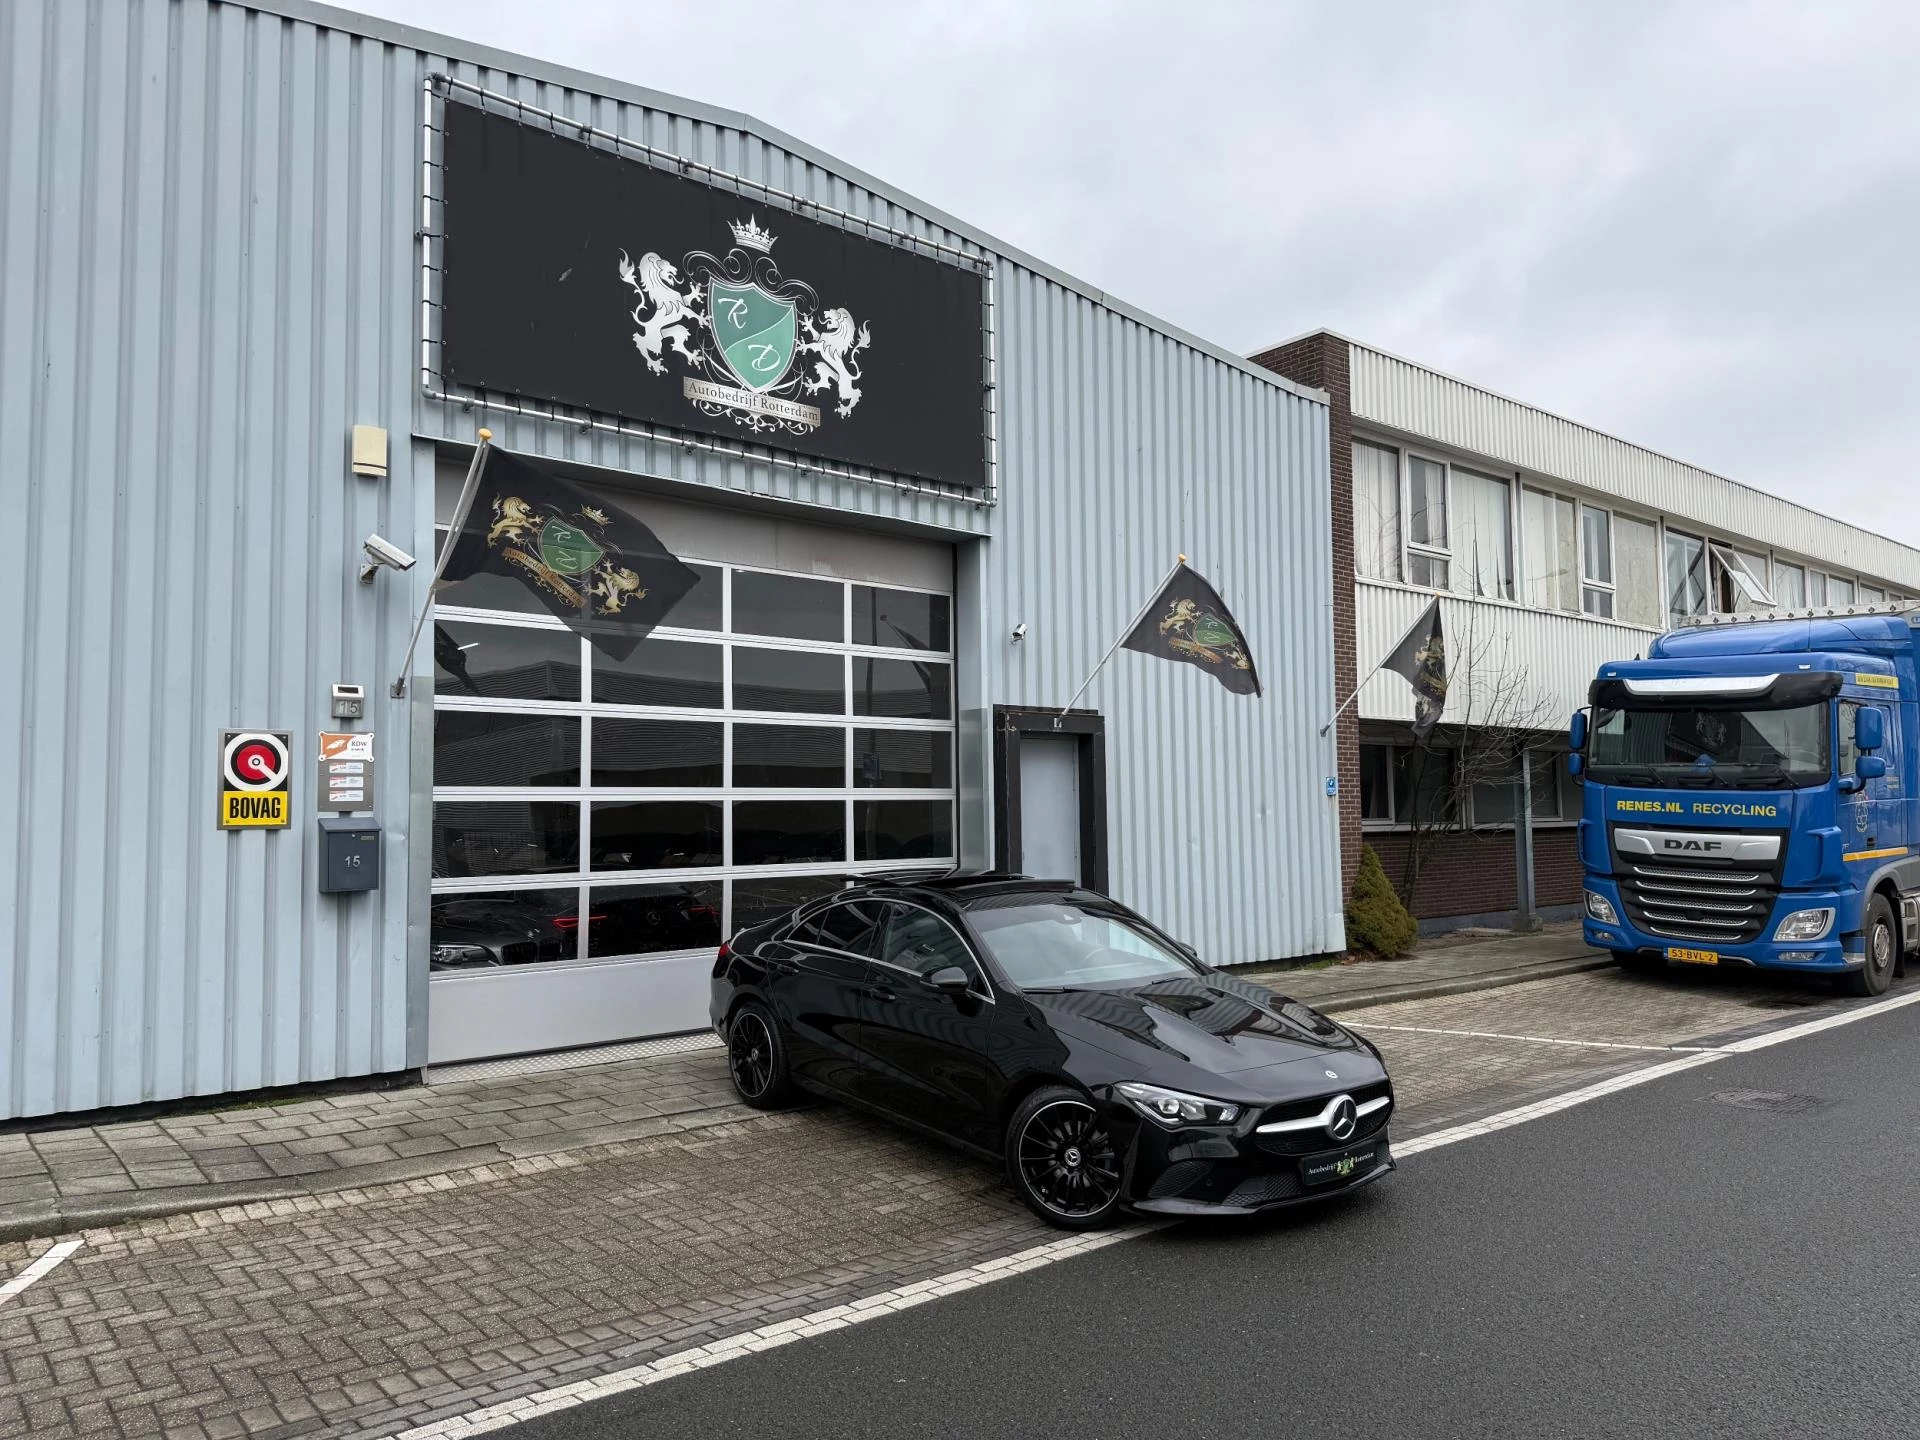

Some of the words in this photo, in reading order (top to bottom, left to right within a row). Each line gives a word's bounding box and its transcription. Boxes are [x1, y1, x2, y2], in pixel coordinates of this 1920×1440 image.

[688, 382, 758, 408] Autobedrijf
[761, 397, 819, 421] Rotterdam
[340, 702, 358, 714] 15
[229, 797, 281, 819] BOVAG
[1616, 800, 1684, 813] RENES.NL
[1693, 803, 1777, 816] RECYCLING
[1664, 839, 1722, 851] DAF
[344, 856, 361, 868] 15
[1671, 949, 1714, 962] 53-BVL-2
